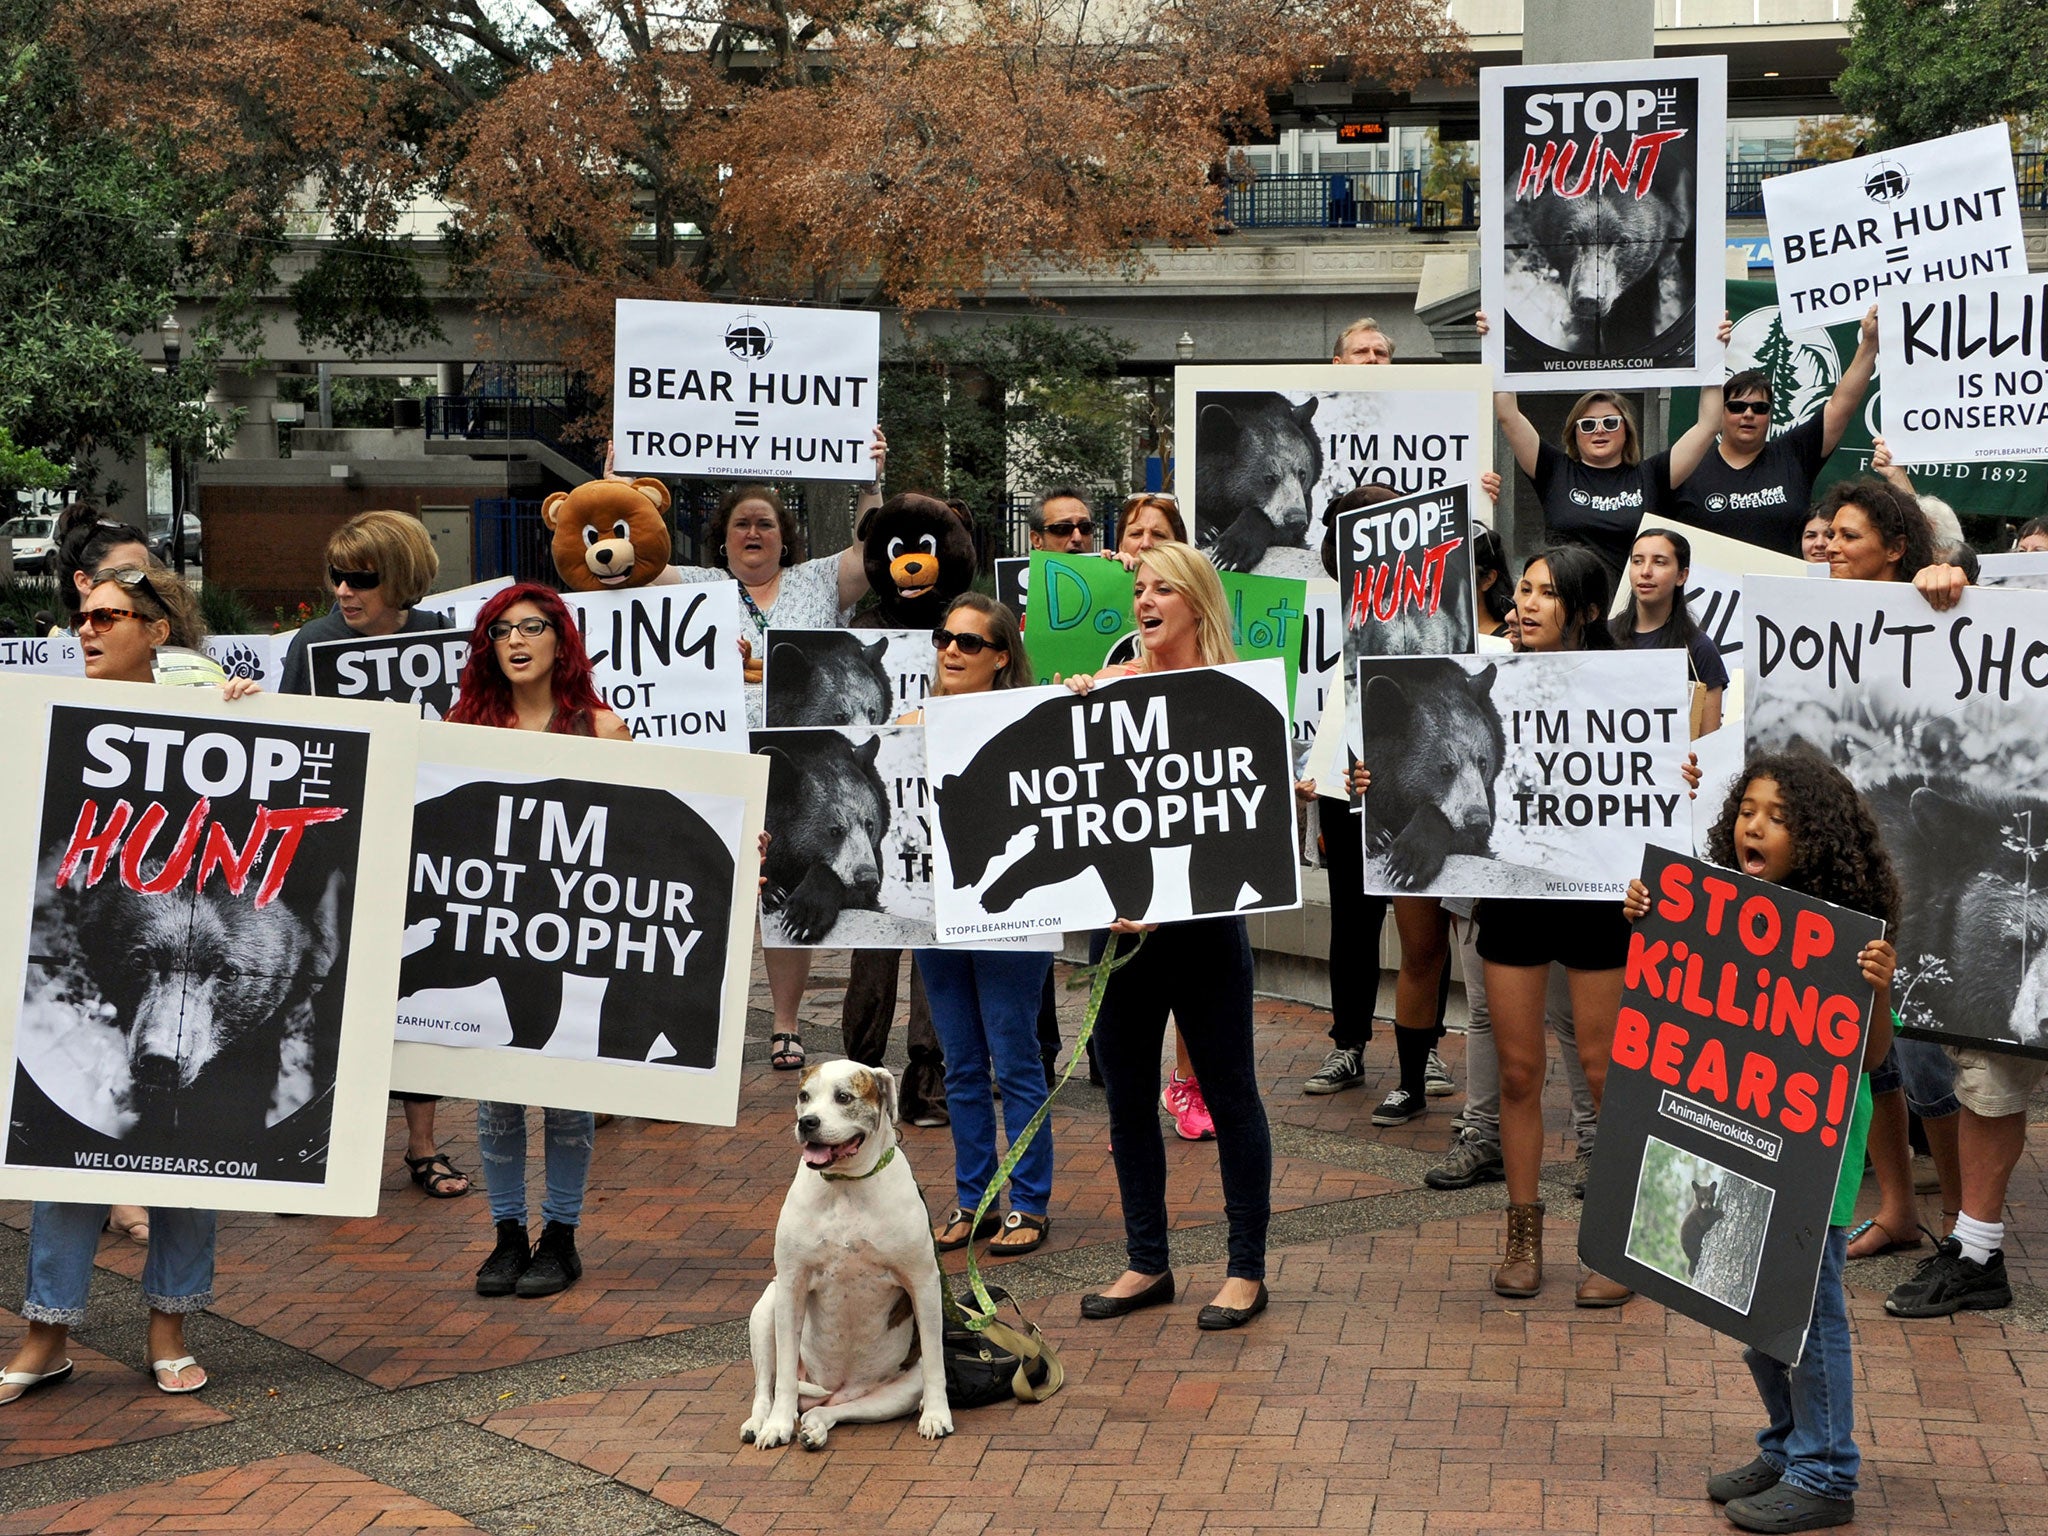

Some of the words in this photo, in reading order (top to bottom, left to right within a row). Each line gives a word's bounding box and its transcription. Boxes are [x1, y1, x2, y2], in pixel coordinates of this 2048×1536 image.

[1525, 89, 1656, 136] STOP
[1657, 87, 1677, 129] THE
[1516, 128, 1689, 201] HUNT
[1783, 217, 1882, 264] BEAR
[1893, 187, 2006, 240] HUNT
[1790, 267, 1912, 314] TROPHY
[1923, 245, 2012, 283] HUNT
[629, 367, 734, 402] BEAR
[749, 372, 868, 408] HUNT
[1543, 358, 1654, 371] WELOVEBEARS.COM
[1958, 373, 1984, 399] IS
[1995, 369, 2048, 397] NO
[626, 431, 760, 459] TROPHY
[771, 436, 864, 464] HUNT
[1330, 434, 1378, 460] I'M
[1394, 434, 1469, 461] NOT
[1859, 457, 1970, 479] FNDED
[1981, 467, 2028, 483] 1892
[707, 467, 793, 476] STOPFLBEARHUNT.COM
[1347, 466, 1447, 494] YOUR
[1730, 492, 1760, 502] BLACK
[1761, 485, 1783, 497] BEAR
[1440, 495, 1455, 542] THE
[1731, 494, 1787, 509] DEFENDER
[1353, 501, 1440, 562] STOP
[1045, 559, 1122, 634] Do
[1348, 536, 1464, 631] HUNT
[0, 641, 48, 665] ING
[62, 645, 76, 659] is
[336, 640, 473, 696] STOP
[1755, 610, 1936, 689] DON'T
[1071, 695, 1170, 760] I'M
[1512, 710, 1570, 744] I'M
[1587, 708, 1678, 744] NOT
[83, 723, 301, 801] STOP
[300, 740, 335, 805] THE
[1008, 762, 1105, 807] NOT
[1125, 746, 1258, 793] YOUR
[1534, 751, 1656, 786] YOUR
[494, 795, 608, 867] I'M
[1040, 784, 1266, 849] TROPHY
[1512, 793, 1681, 827] TROPHY
[56, 797, 350, 911] HUNT
[413, 853, 526, 903] NOT
[550, 867, 695, 924] YOUR
[1545, 882, 1627, 893] WELOVEBEARS.
[945, 917, 1062, 936] STOPFLBEARHUNT.COM
[1658, 862, 1835, 969] STOP
[445, 902, 703, 977] TROPHY
[397, 1015, 481, 1033] EARHUNT.COM
[1611, 1006, 1849, 1147] BEARS!
[1667, 1100, 1777, 1156] Animalherokids.org
[74, 1151, 258, 1177] WELOVEBEARS.COM
